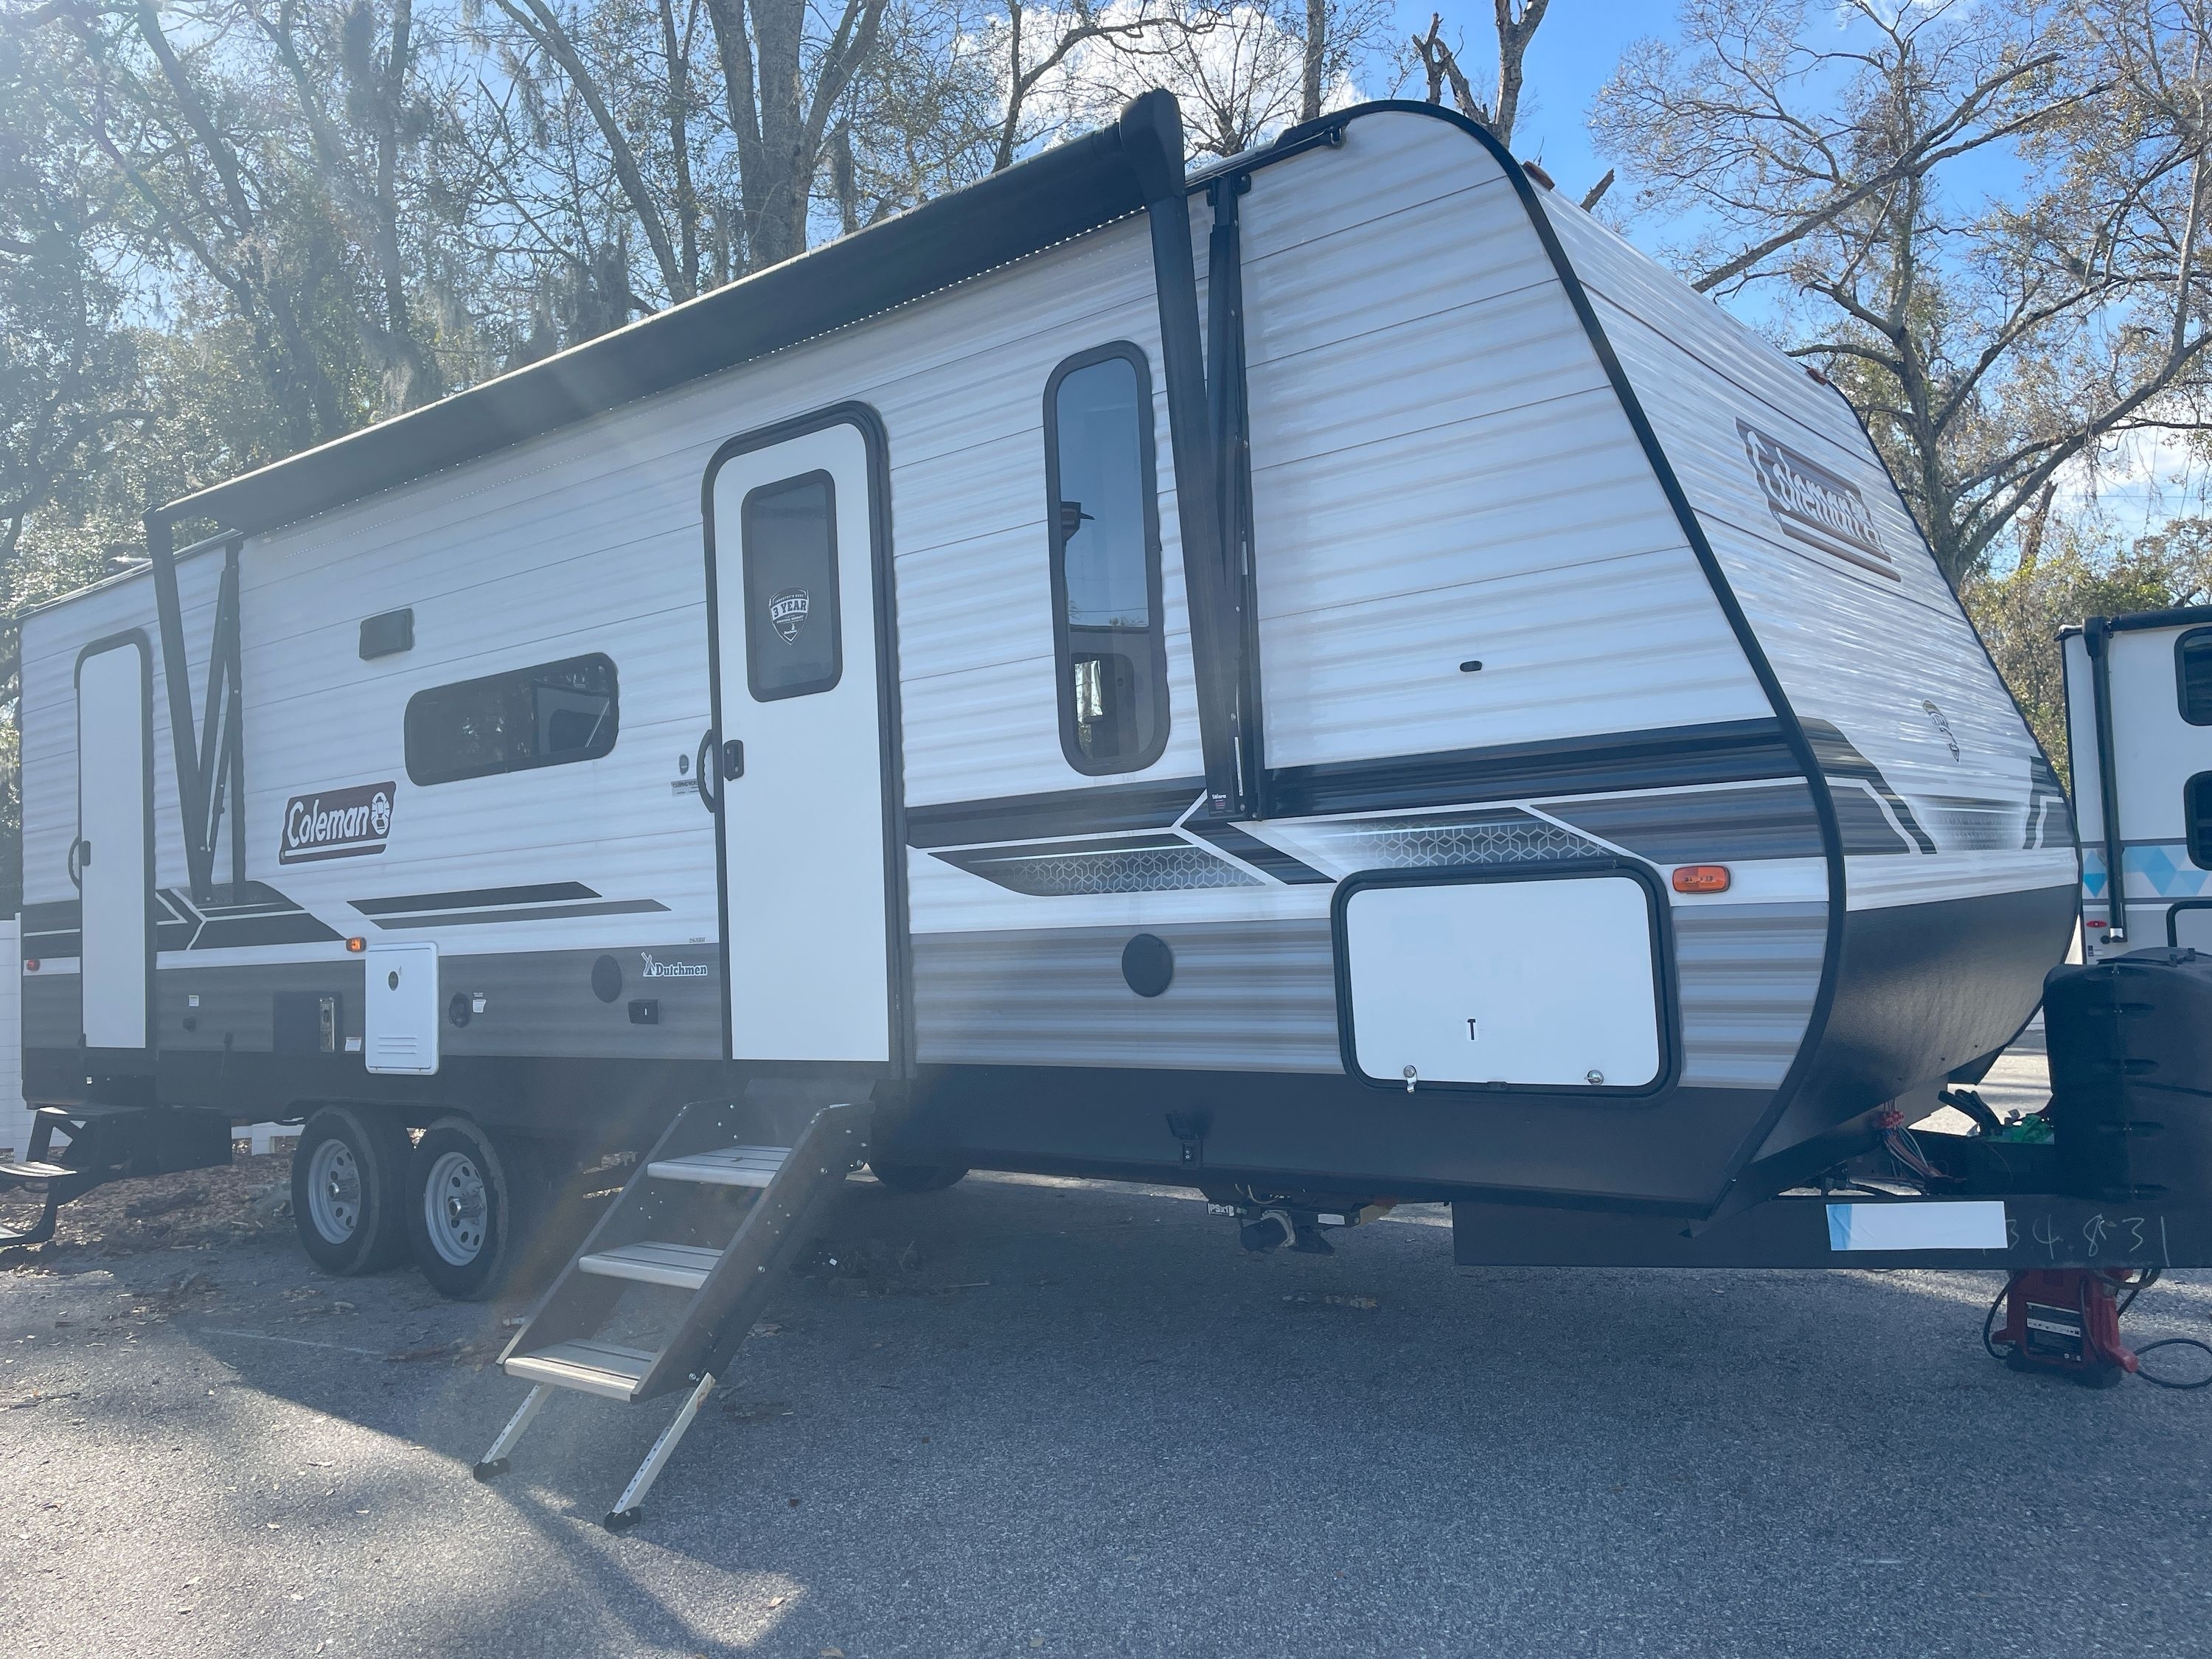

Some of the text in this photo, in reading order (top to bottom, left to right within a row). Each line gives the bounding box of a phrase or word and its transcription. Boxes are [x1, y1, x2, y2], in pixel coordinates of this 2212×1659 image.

[1747, 431, 1867, 543] Coleman
[773, 599, 807, 618] 3 YEAR
[288, 799, 369, 848] Coleman
[655, 962, 708, 977] Dutchmen
[1467, 1018, 1476, 1040] T
